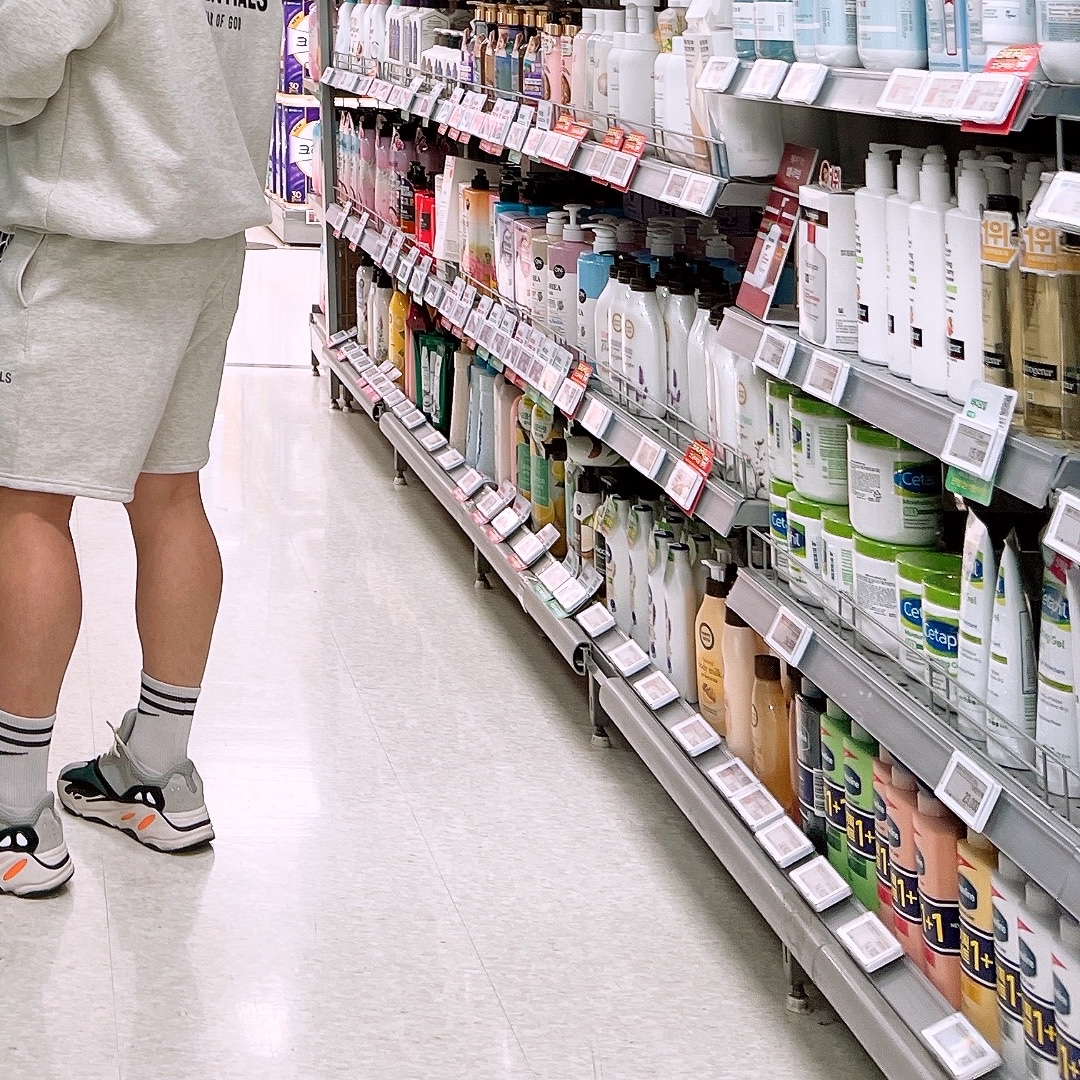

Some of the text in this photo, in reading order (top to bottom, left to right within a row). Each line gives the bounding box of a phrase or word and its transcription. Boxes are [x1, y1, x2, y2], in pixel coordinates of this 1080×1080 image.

[856, 820, 875, 846] 1+
[898, 878, 917, 908] 1+
[970, 939, 994, 971] 1+
[1033, 1009, 1057, 1046] 1+
